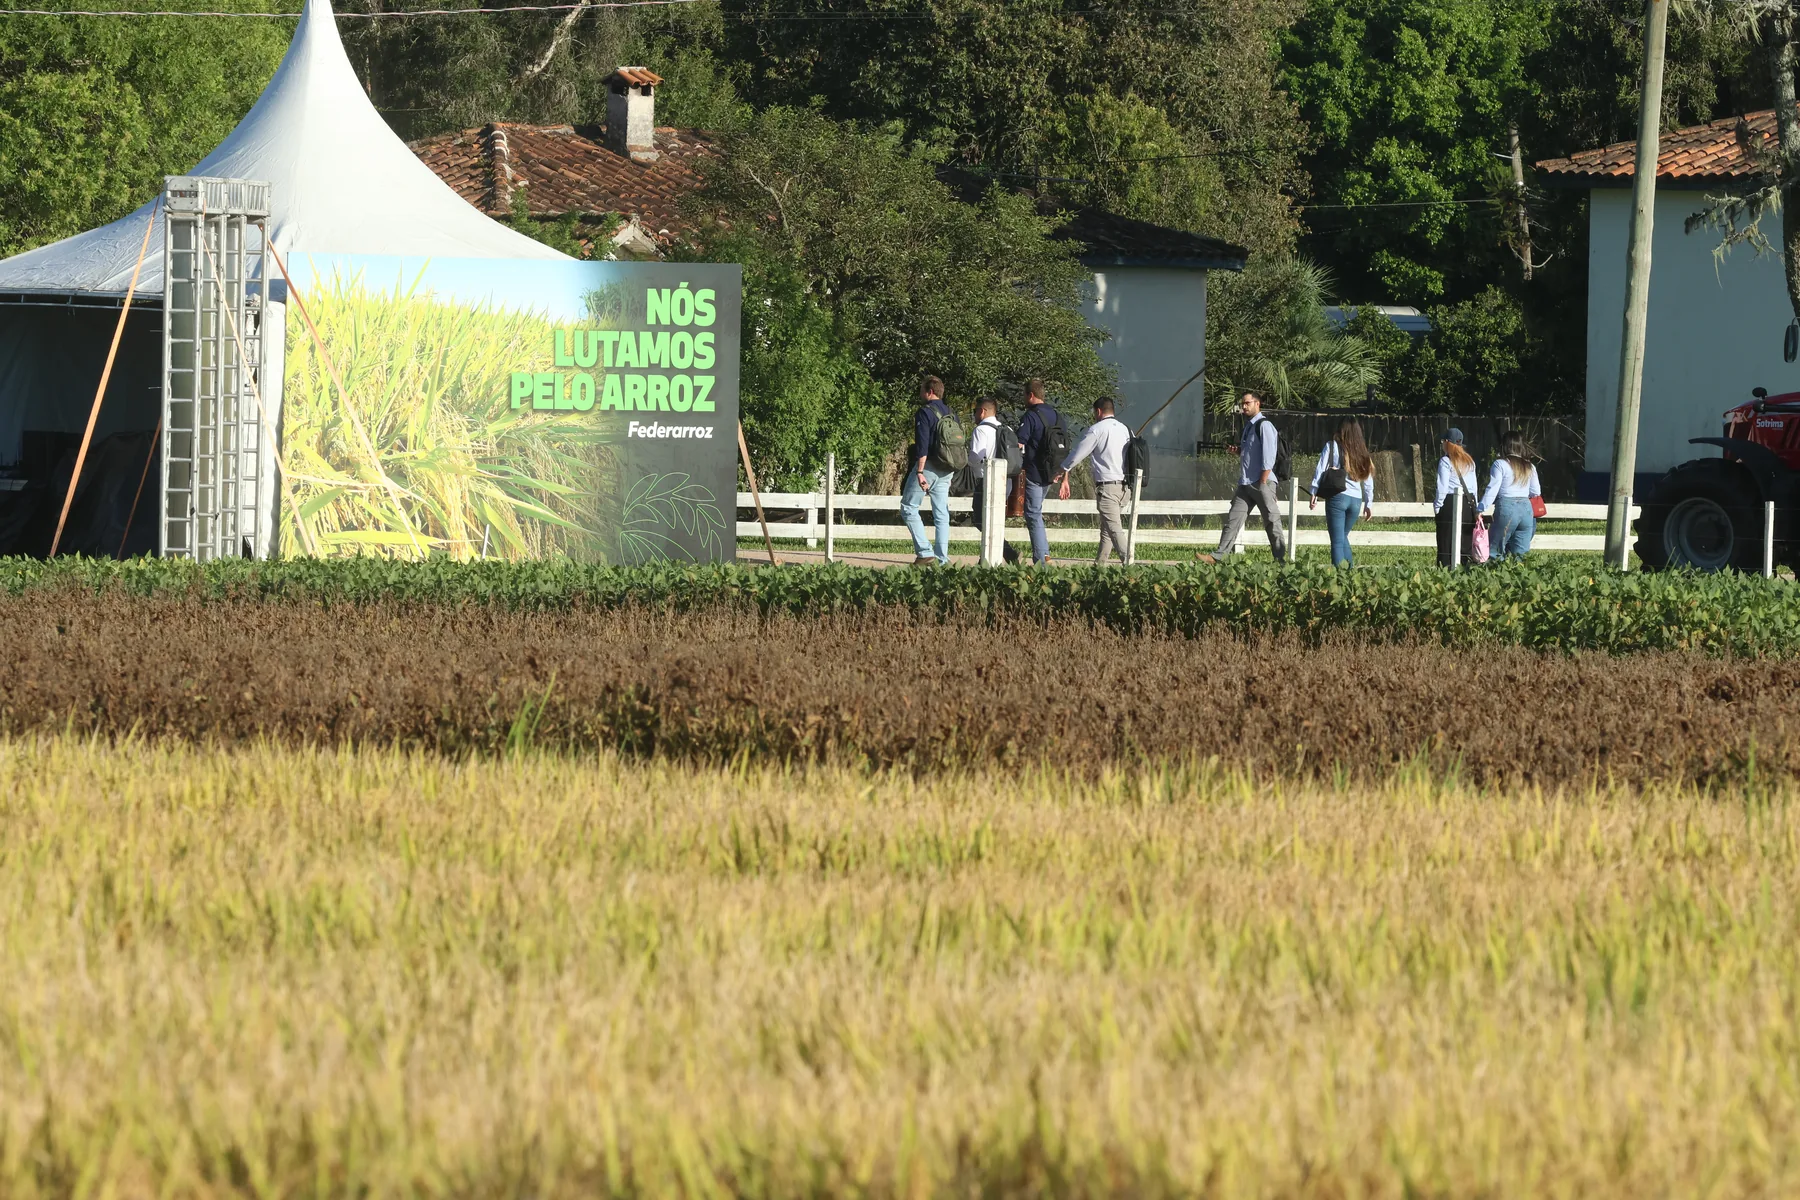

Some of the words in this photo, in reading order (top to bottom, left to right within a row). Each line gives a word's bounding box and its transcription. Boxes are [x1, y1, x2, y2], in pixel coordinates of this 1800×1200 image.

[647, 282, 716, 327] NÓS
[554, 330, 716, 370] LUTAMOS
[511, 372, 596, 411] PELO
[600, 374, 716, 412] ARROZ
[628, 421, 714, 439] Federarroz
[1756, 418, 1783, 428] Sotrima
